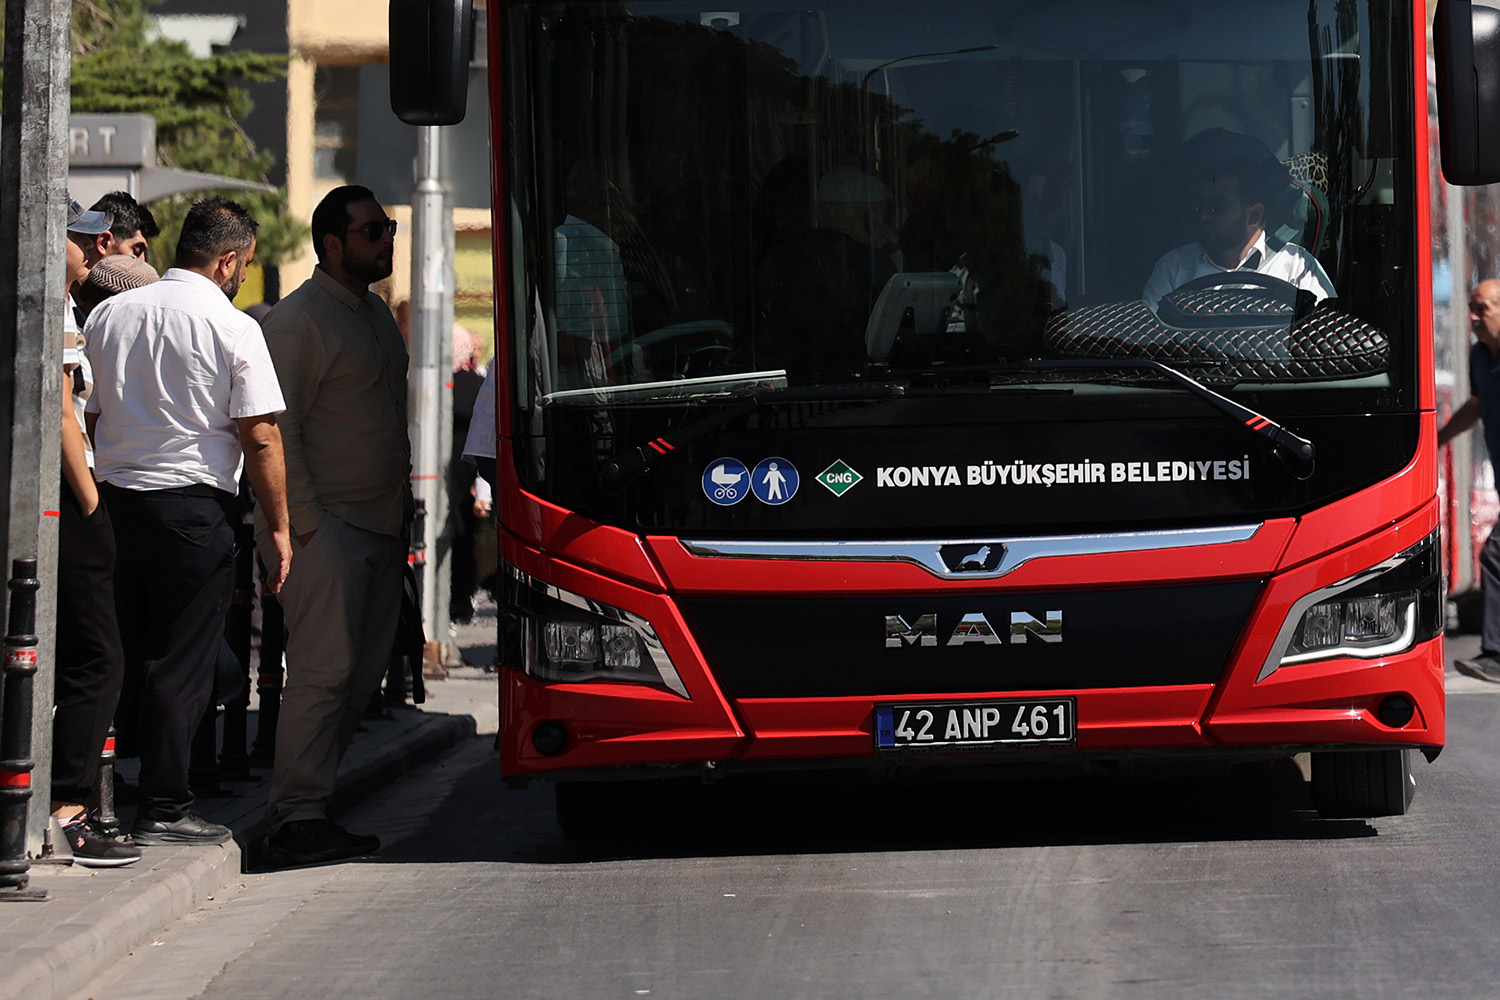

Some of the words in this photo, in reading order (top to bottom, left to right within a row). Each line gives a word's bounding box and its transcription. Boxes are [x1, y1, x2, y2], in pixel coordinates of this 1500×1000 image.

[826, 472, 852, 484] CNG
[876, 466, 962, 487] KONYA
[967, 458, 1106, 488] BÜYÜKŞEHİR
[884, 610, 1063, 648] MAN
[895, 710, 934, 741] 42
[944, 708, 1000, 740] ANP
[1011, 705, 1065, 736] 461
